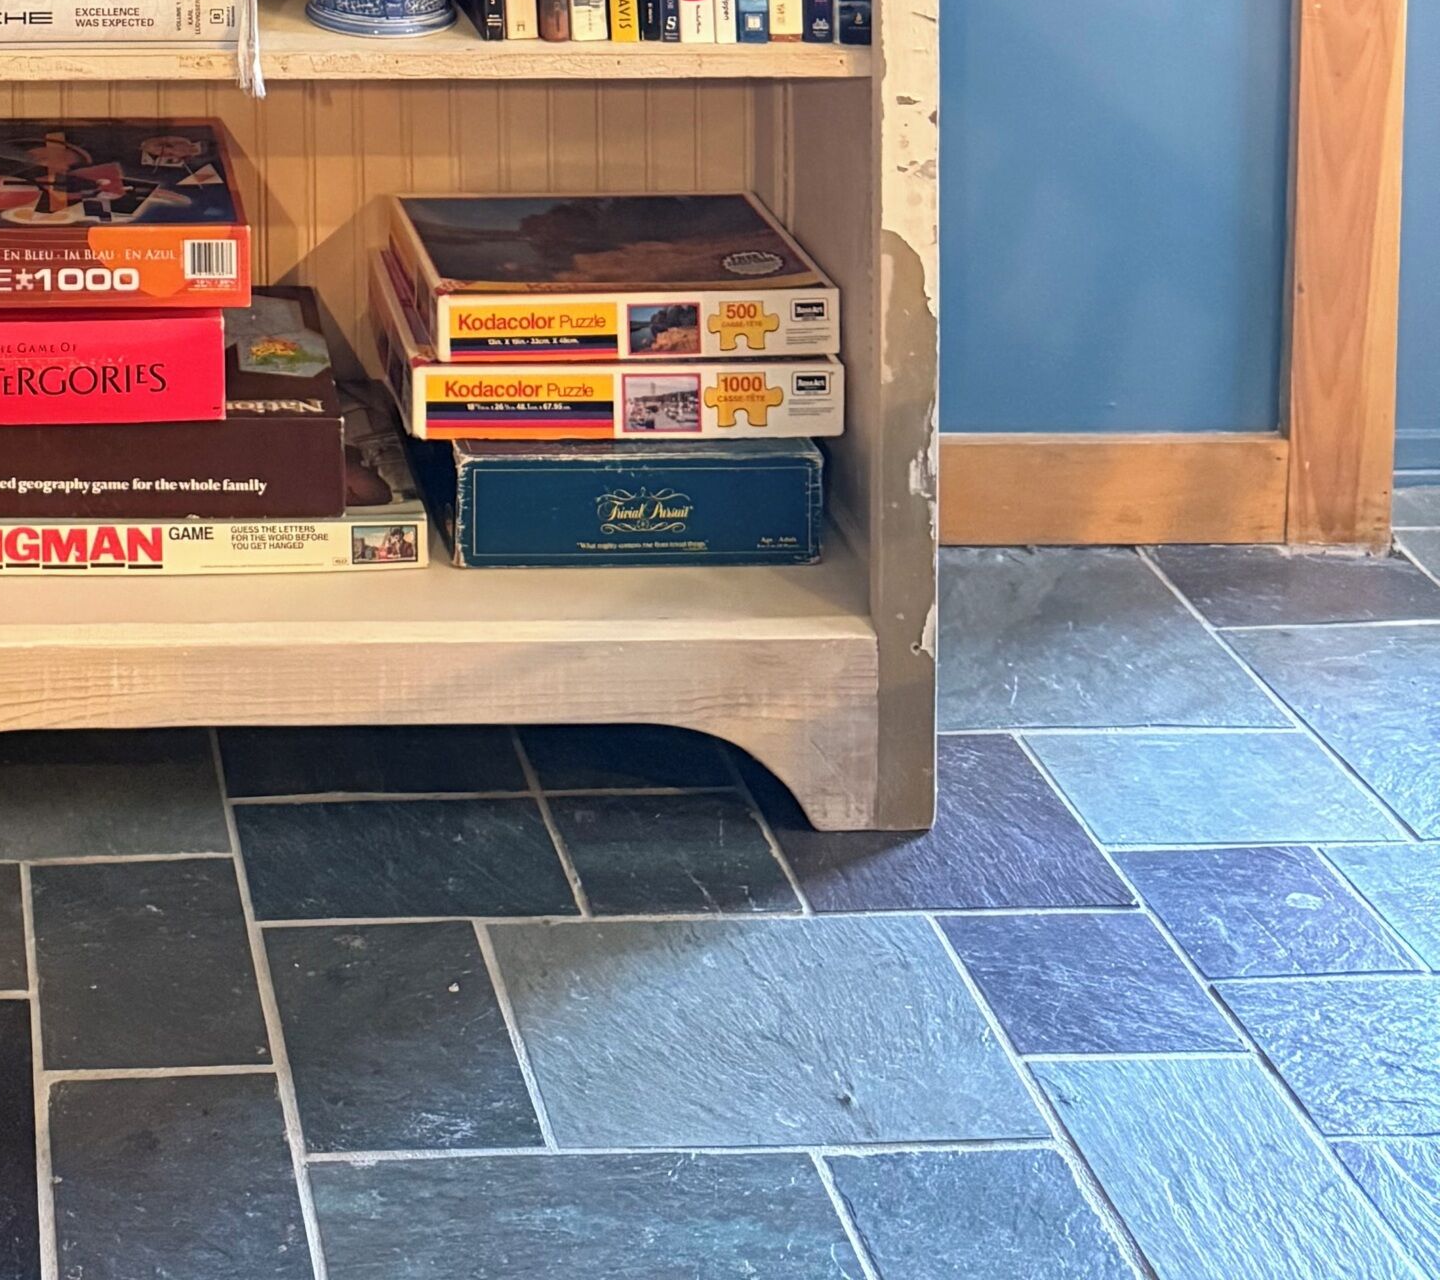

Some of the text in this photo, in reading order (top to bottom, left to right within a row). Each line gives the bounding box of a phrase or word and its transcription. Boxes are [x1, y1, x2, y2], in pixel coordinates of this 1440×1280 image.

[75, 7, 140, 17] EXCELLENCE
[75, 18, 155, 27] WAS EXPECTED
[4, 250, 22, 261] EN
[25, 250, 53, 261] BLEU
[64, 249, 81, 260] IM
[85, 249, 115, 260] BLAU
[125, 249, 143, 260] EN
[145, 249, 176, 260] AZUL
[34, 268, 140, 292] 1000
[726, 303, 757, 319] 500
[458, 313, 606, 331] Kodacolor Puzzle
[445, 380, 594, 398] Kodacolor Puzzle
[721, 376, 762, 392] 1000
[169, 527, 214, 541] GAME
[267, 533, 293, 541] WORD
[294, 533, 328, 541] BEFORE
